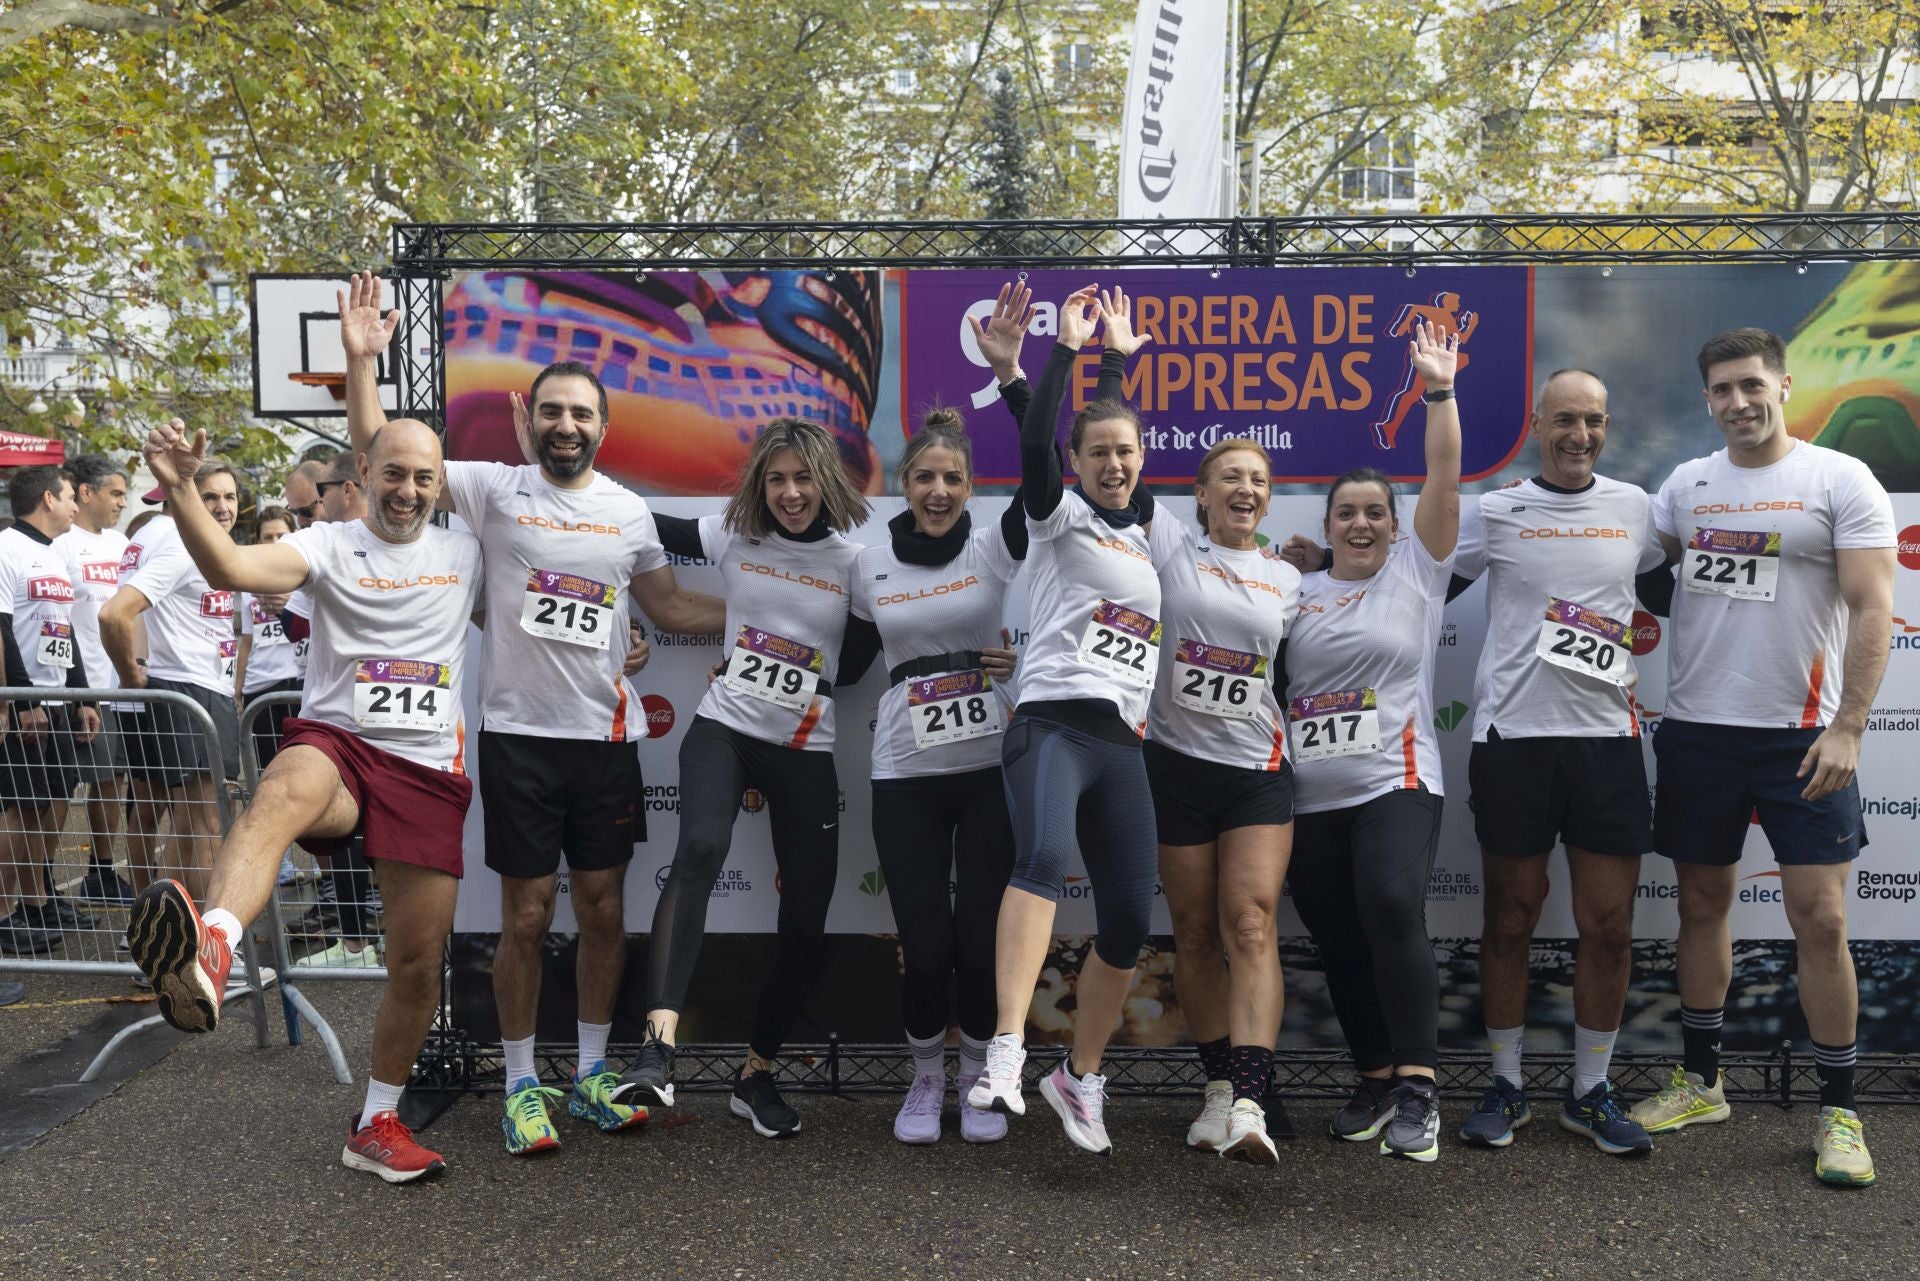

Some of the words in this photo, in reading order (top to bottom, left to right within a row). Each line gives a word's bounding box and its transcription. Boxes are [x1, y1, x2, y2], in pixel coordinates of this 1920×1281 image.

[1313, 294, 1374, 344] DE
[1072, 352, 1373, 412] EMPRESAS
[1140, 425, 1169, 450] rte
[1171, 425, 1197, 451] de
[1693, 501, 1805, 516] COLLOSA
[517, 515, 622, 537] COLLOSA
[1519, 527, 1629, 540] COLLOSA
[740, 562, 843, 595] COLLOSA
[1693, 554, 1757, 585] 221
[35, 581, 75, 599] Helio
[358, 574, 460, 590] COLLOSA
[877, 575, 979, 607] COLLOSA
[534, 597, 599, 633] 215
[261, 623, 283, 639] 45
[1632, 626, 1659, 640] Cola
[45, 639, 71, 659] 458
[1091, 628, 1147, 672] 222
[1550, 628, 1615, 671] 220
[389, 667, 426, 677] EMPRESAS
[738, 654, 803, 695] 219
[1181, 668, 1249, 705] 216
[368, 685, 437, 717] 214
[923, 697, 987, 733] 218
[1868, 707, 1920, 716] untamiento
[1301, 714, 1362, 748] 217
[728, 870, 744, 880] DE
[1429, 874, 1452, 884] NCO
[1455, 874, 1471, 884] DE
[1858, 871, 1920, 885] Renau
[713, 881, 752, 891] ENTOS
[1428, 885, 1480, 895] IMENTOS
[1739, 884, 1782, 903] elec
[1857, 884, 1917, 903] Group
